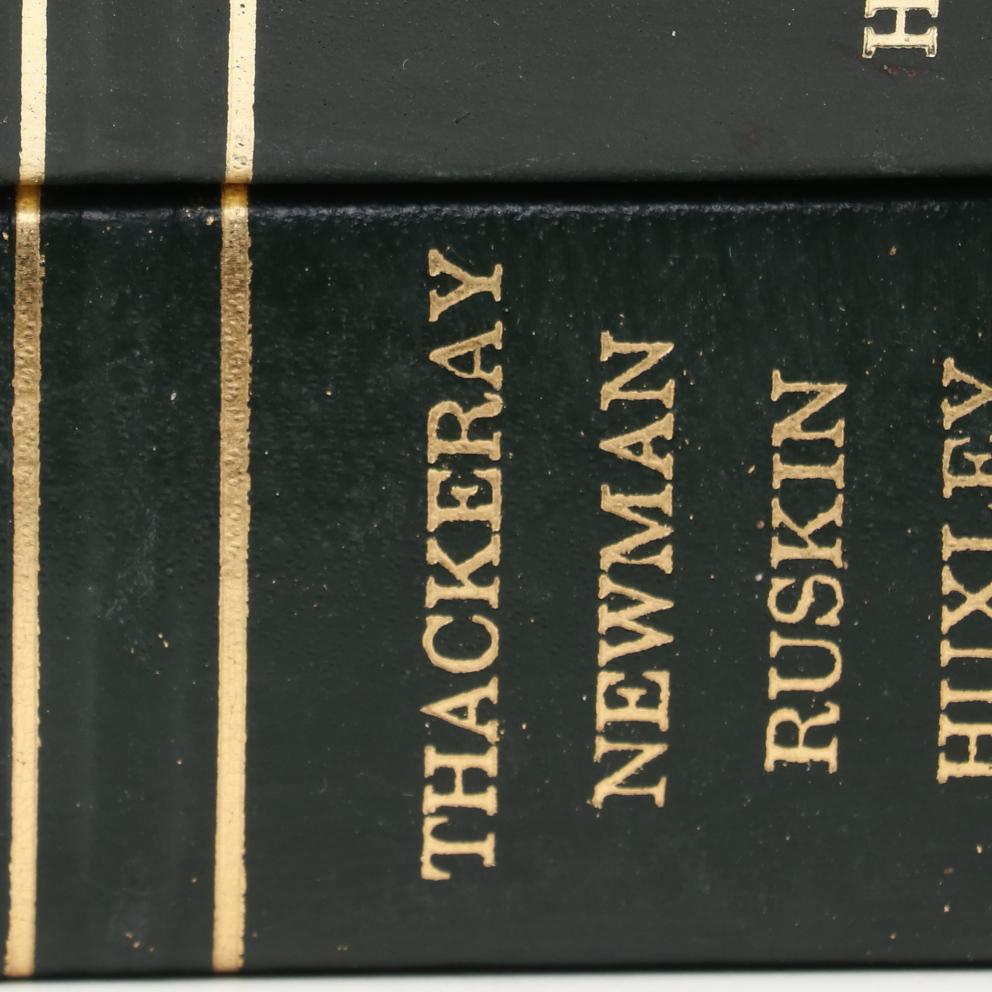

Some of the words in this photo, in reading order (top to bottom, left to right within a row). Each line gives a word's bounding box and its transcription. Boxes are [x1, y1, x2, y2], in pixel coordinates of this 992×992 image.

[419, 248, 504, 882] THACKERAY
[591, 330, 676, 810] NEWMAN
[764, 369, 848, 774] RUSKIN
